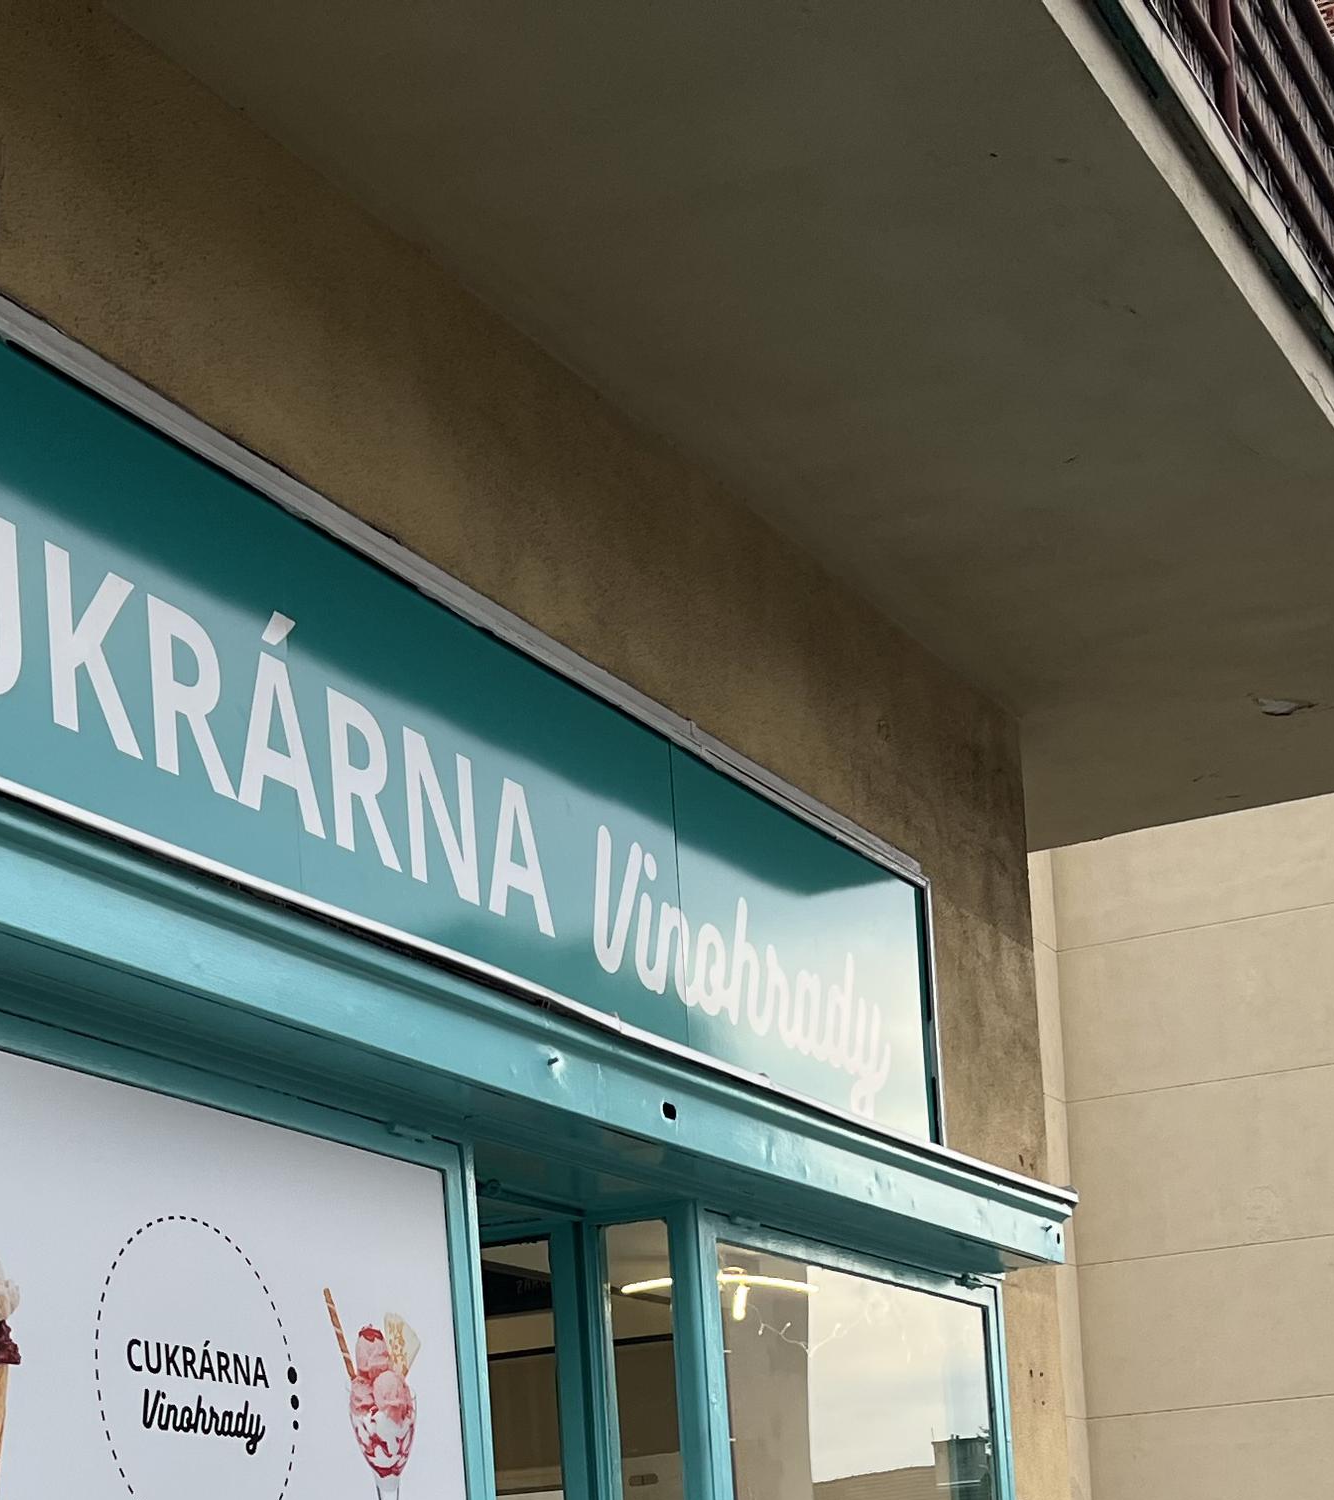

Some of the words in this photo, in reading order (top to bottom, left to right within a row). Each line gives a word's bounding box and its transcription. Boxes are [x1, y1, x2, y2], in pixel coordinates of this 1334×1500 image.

[593, 824, 892, 1120] Vinohrady
[126, 1338, 270, 1389] CUKRÁRNA
[142, 1388, 267, 1455] Vinohrady
